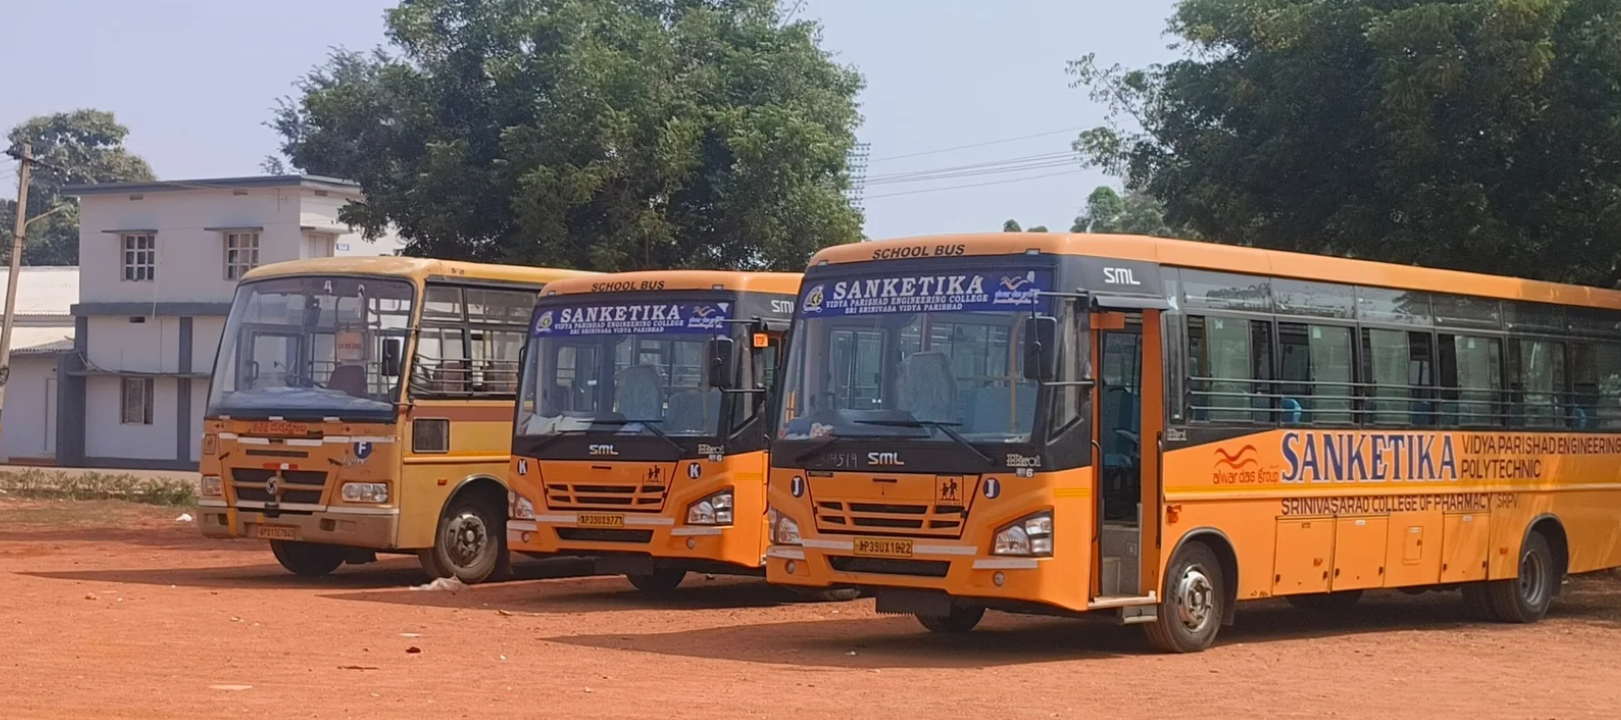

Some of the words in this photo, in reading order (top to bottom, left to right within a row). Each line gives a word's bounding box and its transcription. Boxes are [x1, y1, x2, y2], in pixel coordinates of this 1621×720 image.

[872, 246, 929, 259] SCHOOL
[934, 244, 965, 256] BUS
[1103, 267, 1141, 285] SML
[591, 281, 636, 292] SCHOOL
[640, 280, 665, 290] BUS
[833, 275, 984, 300] SANKETIKA
[826, 299, 848, 308] VIDYA
[850, 297, 889, 307] PARISHAD
[891, 295, 947, 305] ENGINEERING
[949, 294, 989, 303] COLLEGE
[859, 305, 897, 313] SRINIVASA
[899, 304, 921, 312] VIDYA
[923, 303, 963, 311] PARISHAD
[560, 304, 680, 323] SANKETIKA
[555, 322, 573, 330] VIDYA
[653, 319, 685, 327] COLLEGE
[358, 441, 367, 455] F
[589, 444, 619, 455] SML
[1462, 434, 1497, 454] VIDYA
[1498, 435, 1557, 455] PARISHAD
[1558, 436, 1621, 455] ENGINEERING
[867, 452, 905, 465] SML
[1280, 432, 1458, 483] SANKETIKA
[519, 460, 527, 474] K
[690, 464, 700, 477] K
[1461, 459, 1541, 479] POLYTECHNIC
[793, 477, 801, 496] J
[985, 479, 995, 498] J
[1281, 496, 1370, 515] SRINIVASARAO
[1371, 496, 1417, 512] COLLEGE
[1419, 495, 1433, 511] OF
[1434, 493, 1492, 511] PHARMACY
